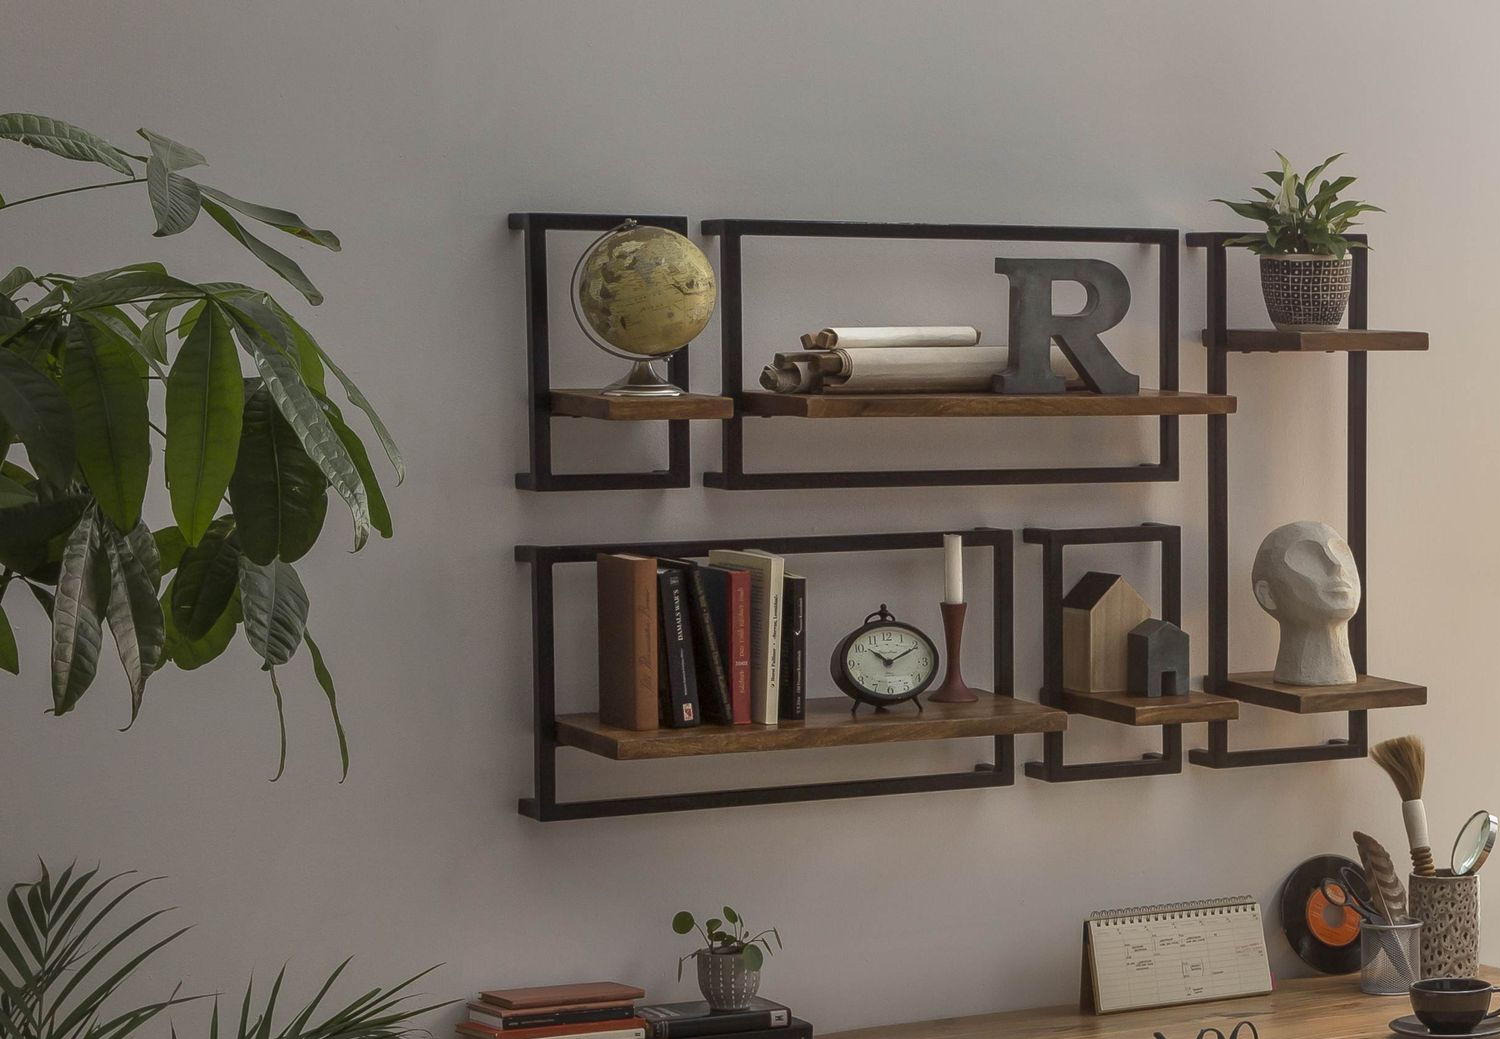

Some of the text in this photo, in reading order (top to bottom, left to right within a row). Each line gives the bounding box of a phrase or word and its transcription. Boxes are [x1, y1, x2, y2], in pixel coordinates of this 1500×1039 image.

[991, 257, 1140, 394] R
[675, 612, 684, 641] DAMALS
[868, 636, 877, 645] 11
[882, 632, 892, 641] 12
[854, 644, 864, 653] 10
[911, 641, 919, 649] 2
[848, 660, 855, 669] 9
[921, 657, 929, 666] 3
[857, 675, 864, 685] 8
[915, 673, 921, 682] 4
[872, 683, 878, 692] 7
[887, 686, 894, 694] 6
[903, 682, 910, 691] 5
